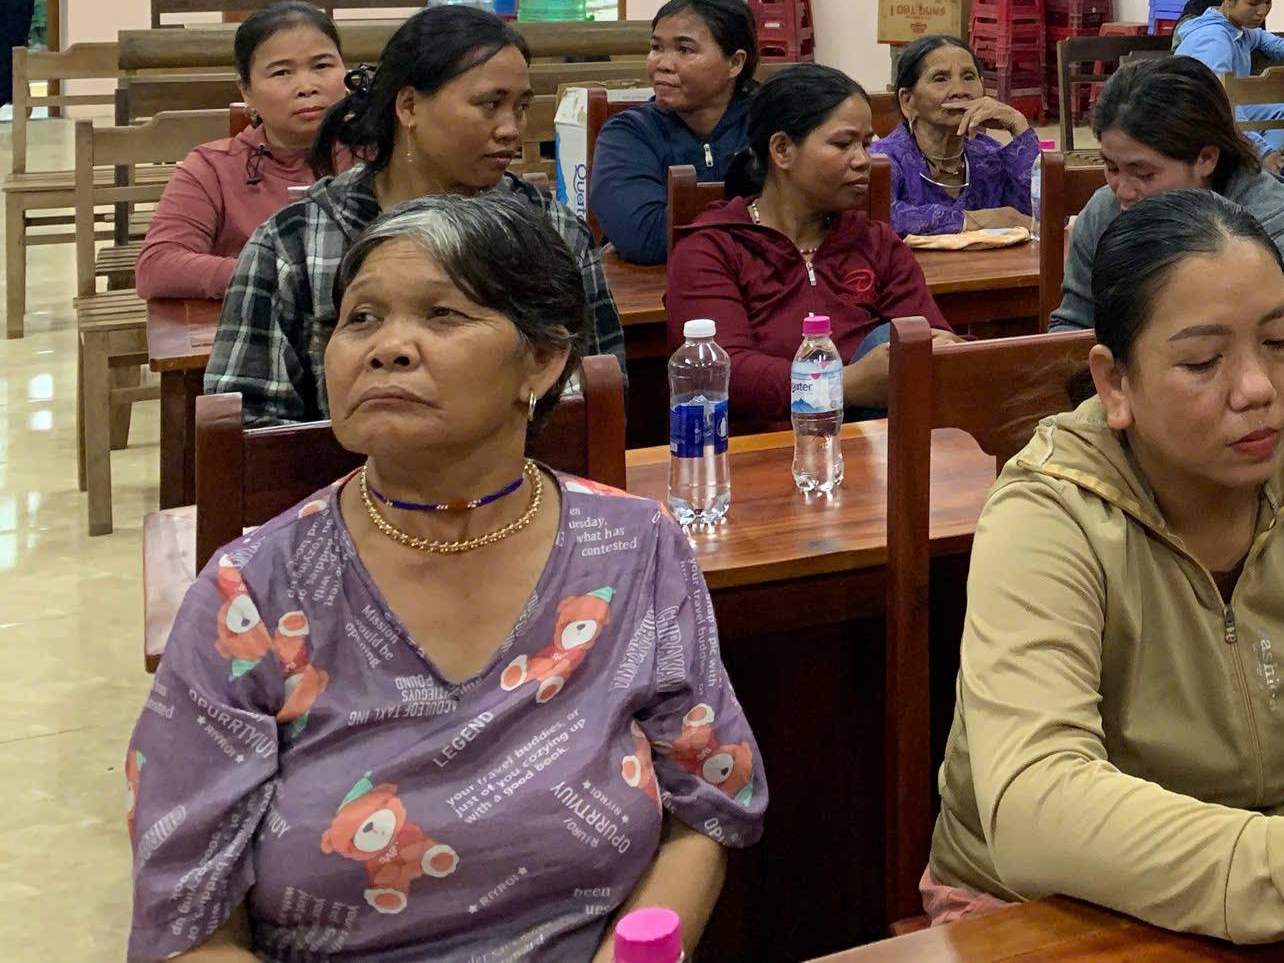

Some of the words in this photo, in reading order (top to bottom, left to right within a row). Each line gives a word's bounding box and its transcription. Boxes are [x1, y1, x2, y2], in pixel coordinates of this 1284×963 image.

[581, 538, 638, 557] contested
[604, 526, 625, 539] has
[688, 557, 699, 586] your
[361, 604, 399, 644] Mission
[381, 645, 394, 661] be
[432, 711, 494, 768] LEGEND
[445, 785, 475, 806] your
[476, 757, 514, 785] travel
[454, 795, 480, 818] just
[481, 784, 495, 797] of
[496, 768, 521, 788] you
[522, 733, 569, 768] cozying
[570, 718, 586, 733] up
[464, 801, 492, 824] with
[503, 770, 535, 797] good
